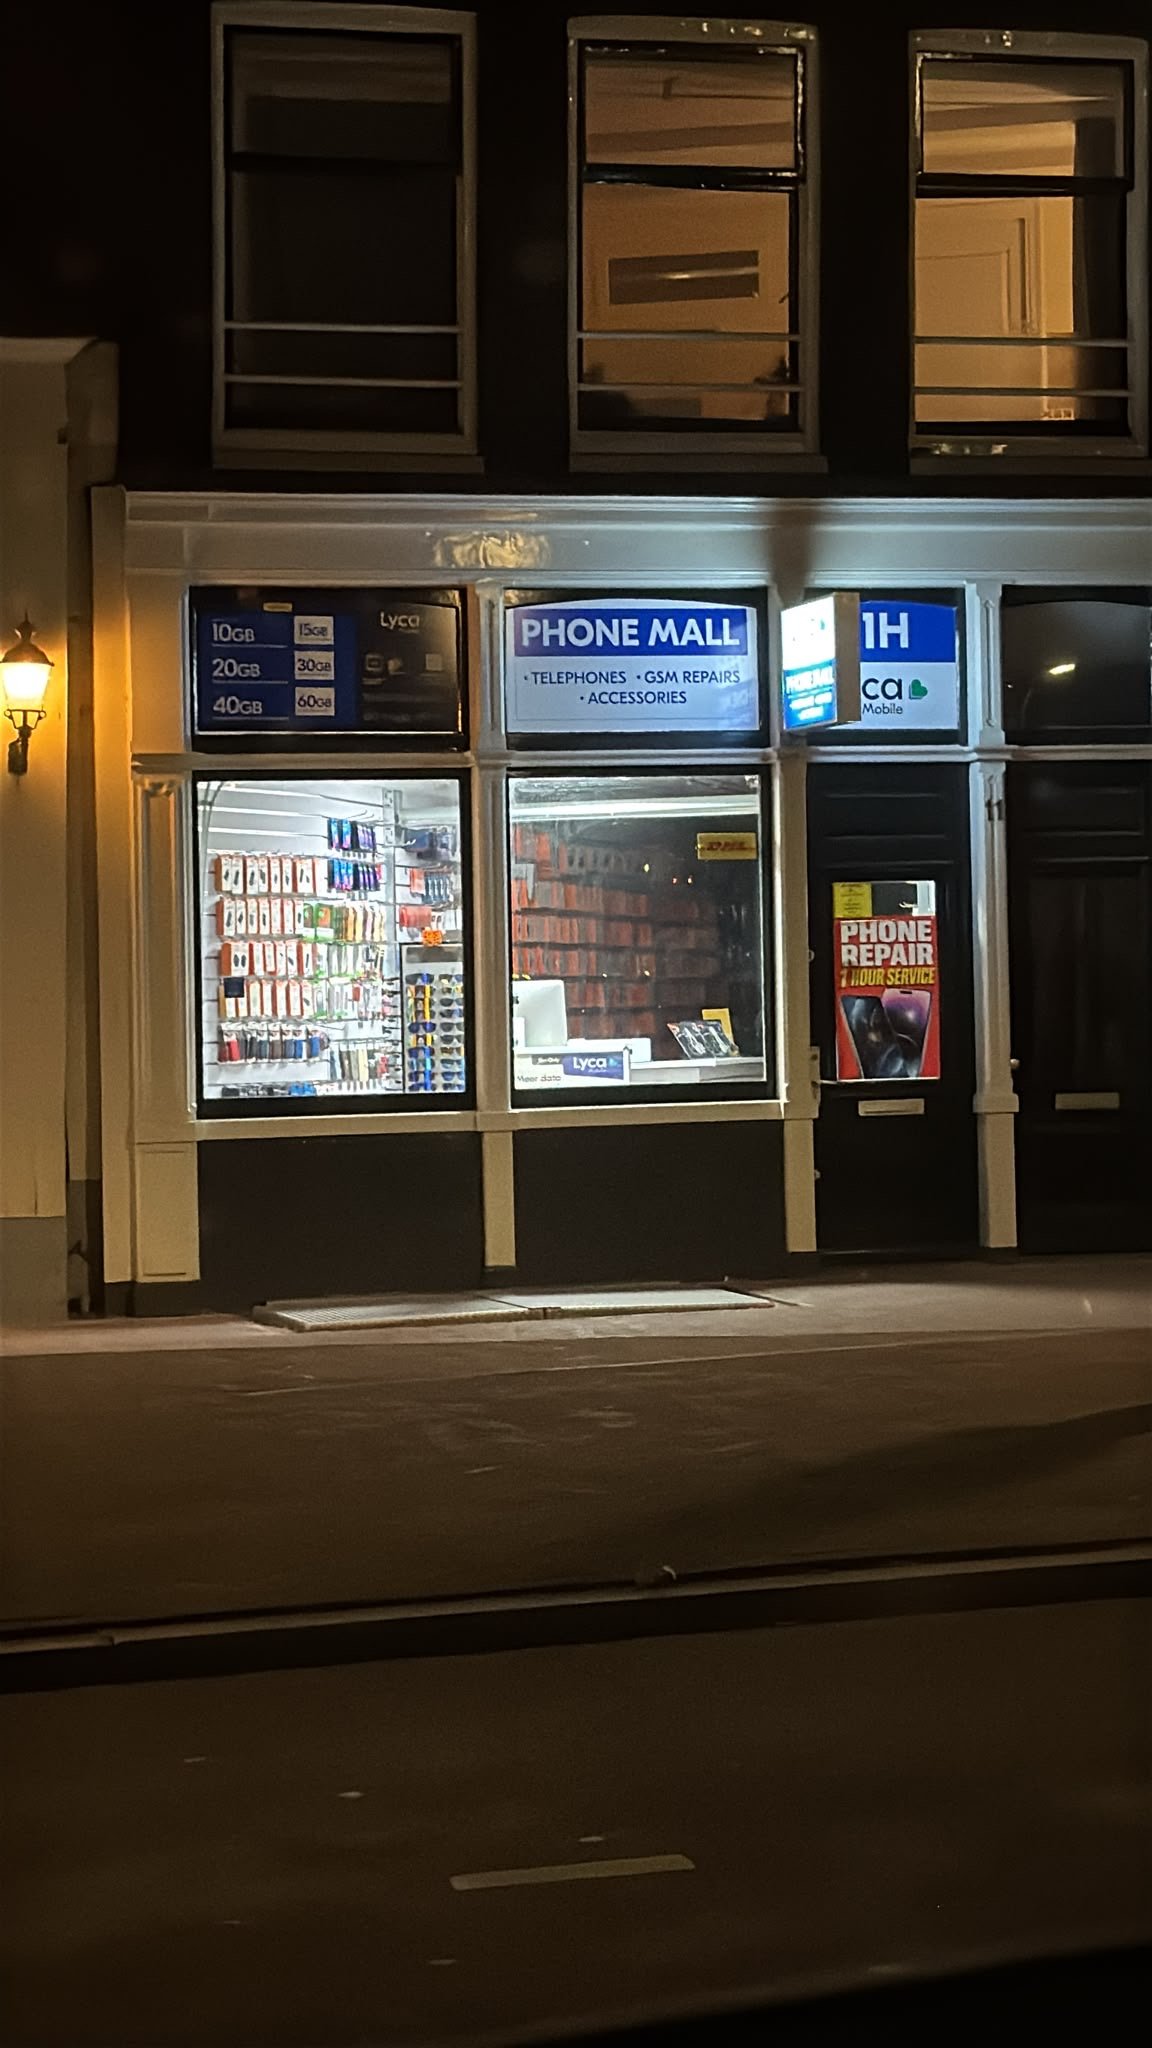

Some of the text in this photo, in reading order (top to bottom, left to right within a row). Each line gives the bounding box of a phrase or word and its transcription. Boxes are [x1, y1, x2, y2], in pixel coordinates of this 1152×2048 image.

[379, 611, 420, 629] Lyca
[212, 623, 255, 643] 10GB
[299, 623, 328, 637] 15GB
[521, 617, 740, 647] PHONE MALL
[212, 658, 261, 678] 20GB
[297, 658, 332, 672] 30GB
[531, 670, 741, 685] TELEPHONES GSM REPAIRS
[588, 691, 687, 704] ACCESSORIES
[862, 678, 903, 700] ca
[212, 696, 263, 714] 40GB
[297, 695, 332, 708] 60GB
[862, 703, 903, 715] Mobile
[840, 920, 932, 943] PHONE
[841, 943, 934, 967] REPAIR
[851, 968, 885, 986] HOUR
[886, 967, 936, 986] SERVICE
[573, 1056, 607, 1071] Lyca
